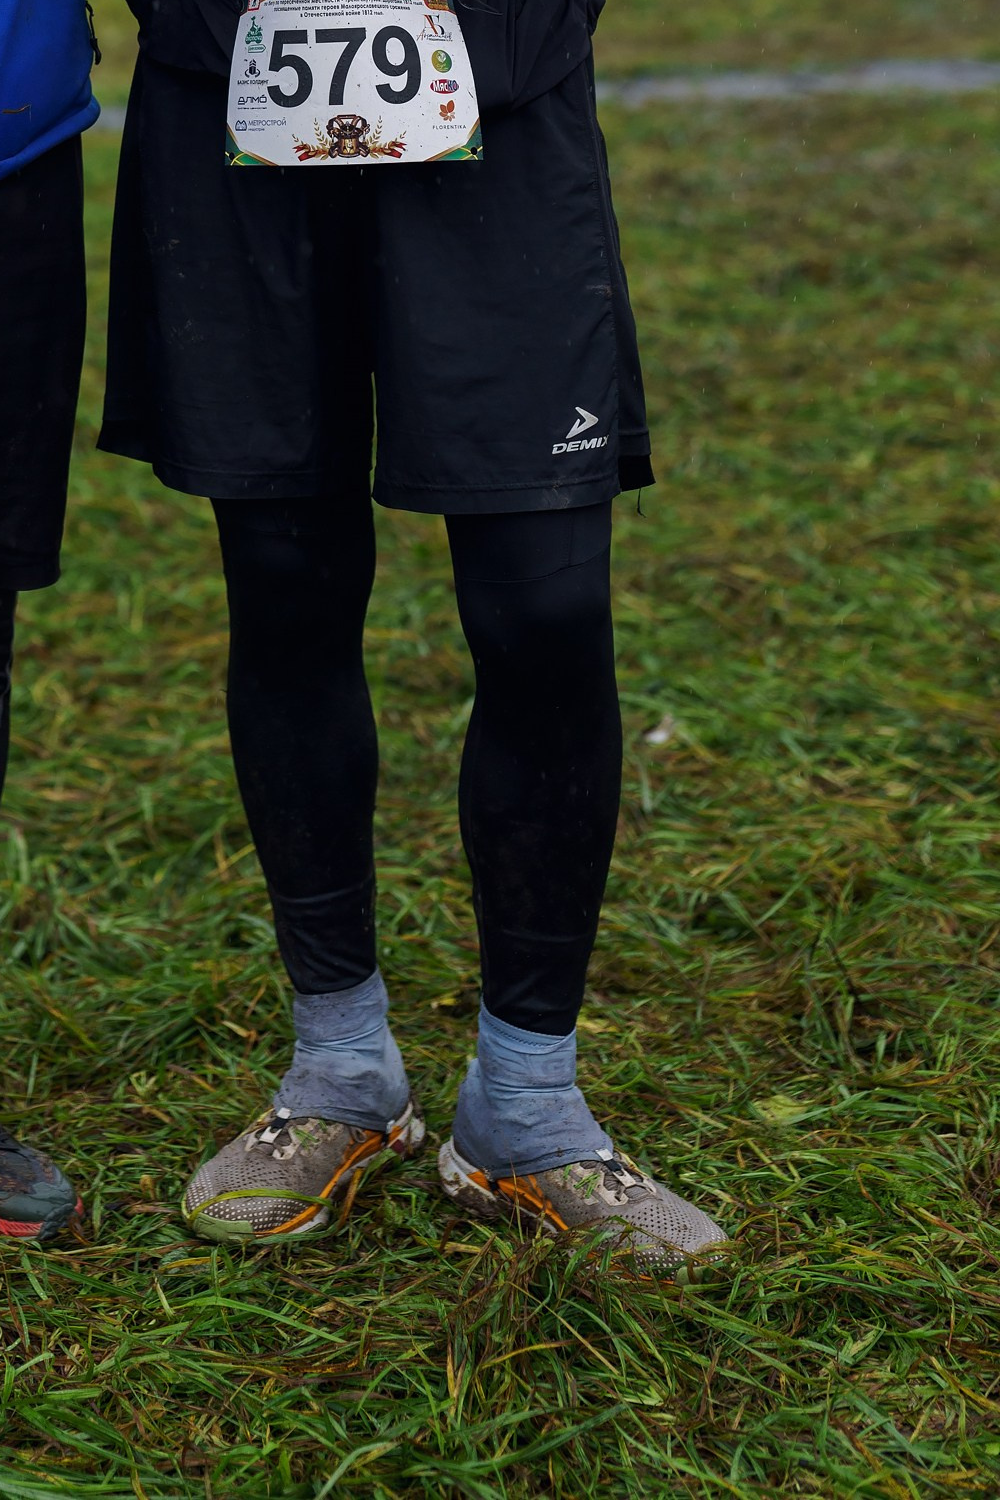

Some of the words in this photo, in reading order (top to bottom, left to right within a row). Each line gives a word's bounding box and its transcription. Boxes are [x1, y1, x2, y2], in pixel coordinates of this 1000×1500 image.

[267, 25, 422, 108] 579
[248, 118, 287, 126] МЕТРОСТРОЙ
[551, 434, 610, 455] DEMIX
